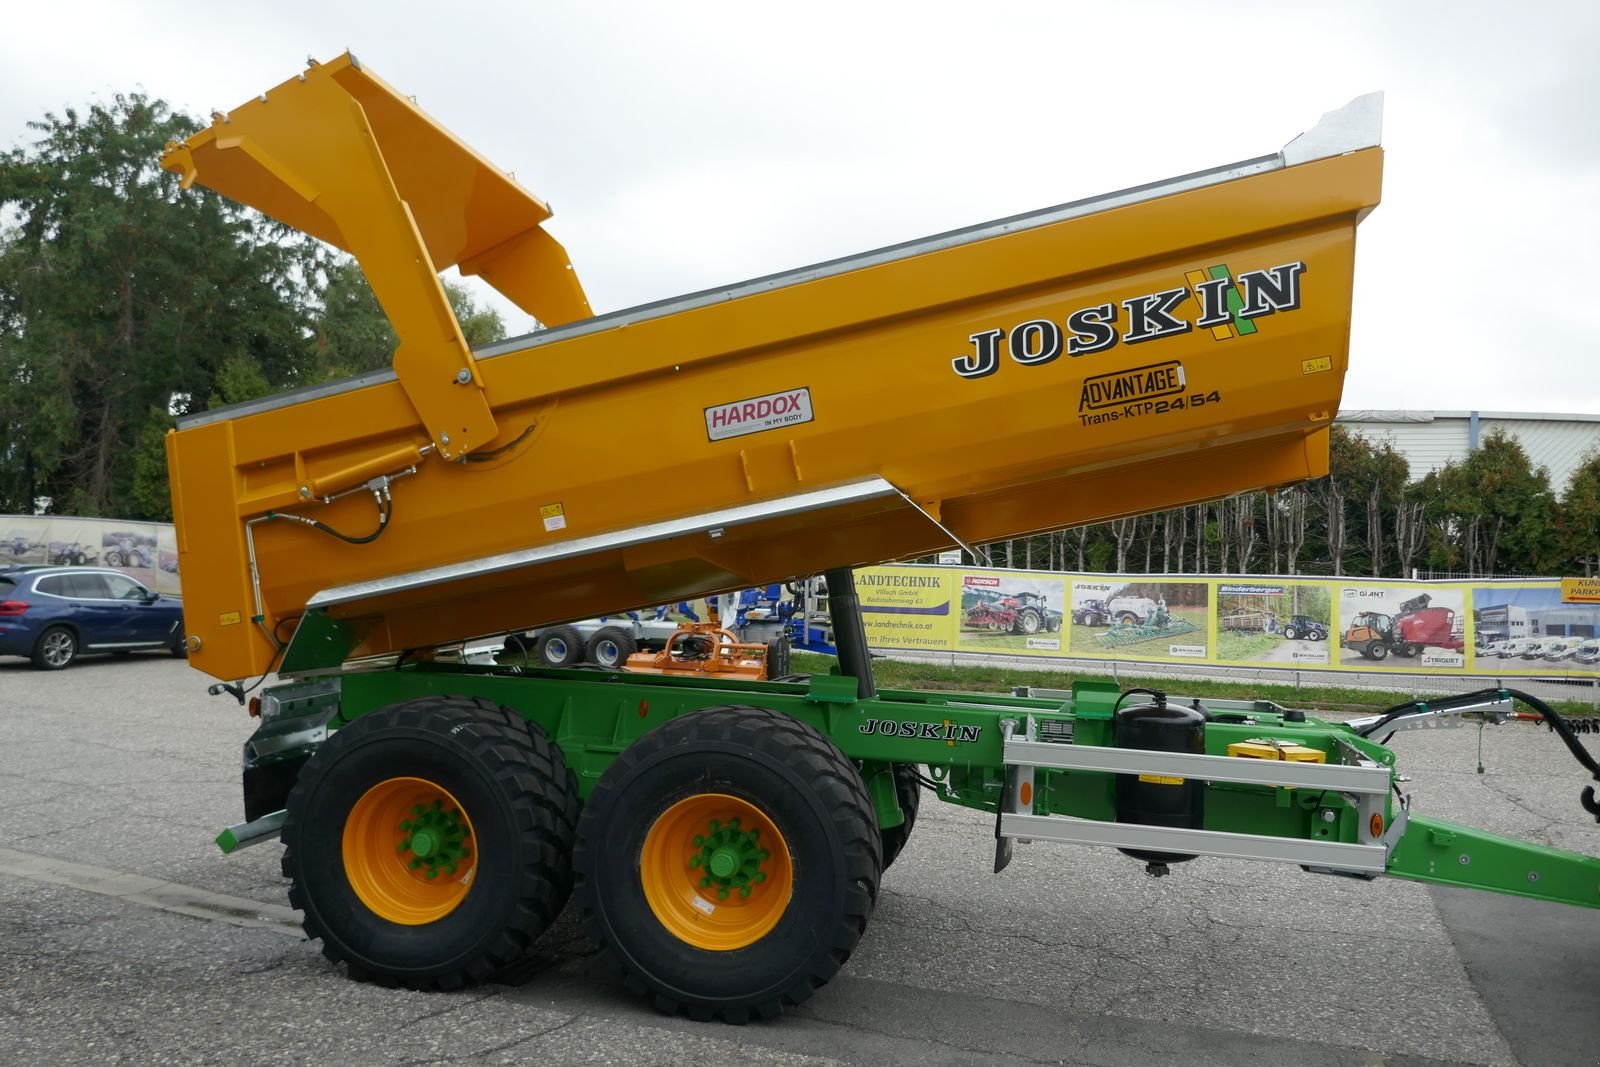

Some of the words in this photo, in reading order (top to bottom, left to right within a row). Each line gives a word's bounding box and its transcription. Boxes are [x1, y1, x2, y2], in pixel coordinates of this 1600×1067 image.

[952, 262, 1307, 379] JOSKIN
[1079, 367, 1178, 412] ADVANTAGE
[784, 413, 802, 422] BODY
[971, 577, 998, 586] HORSCH
[902, 636, 948, 646] Vertrauens
[858, 718, 982, 743] JOSKIN
